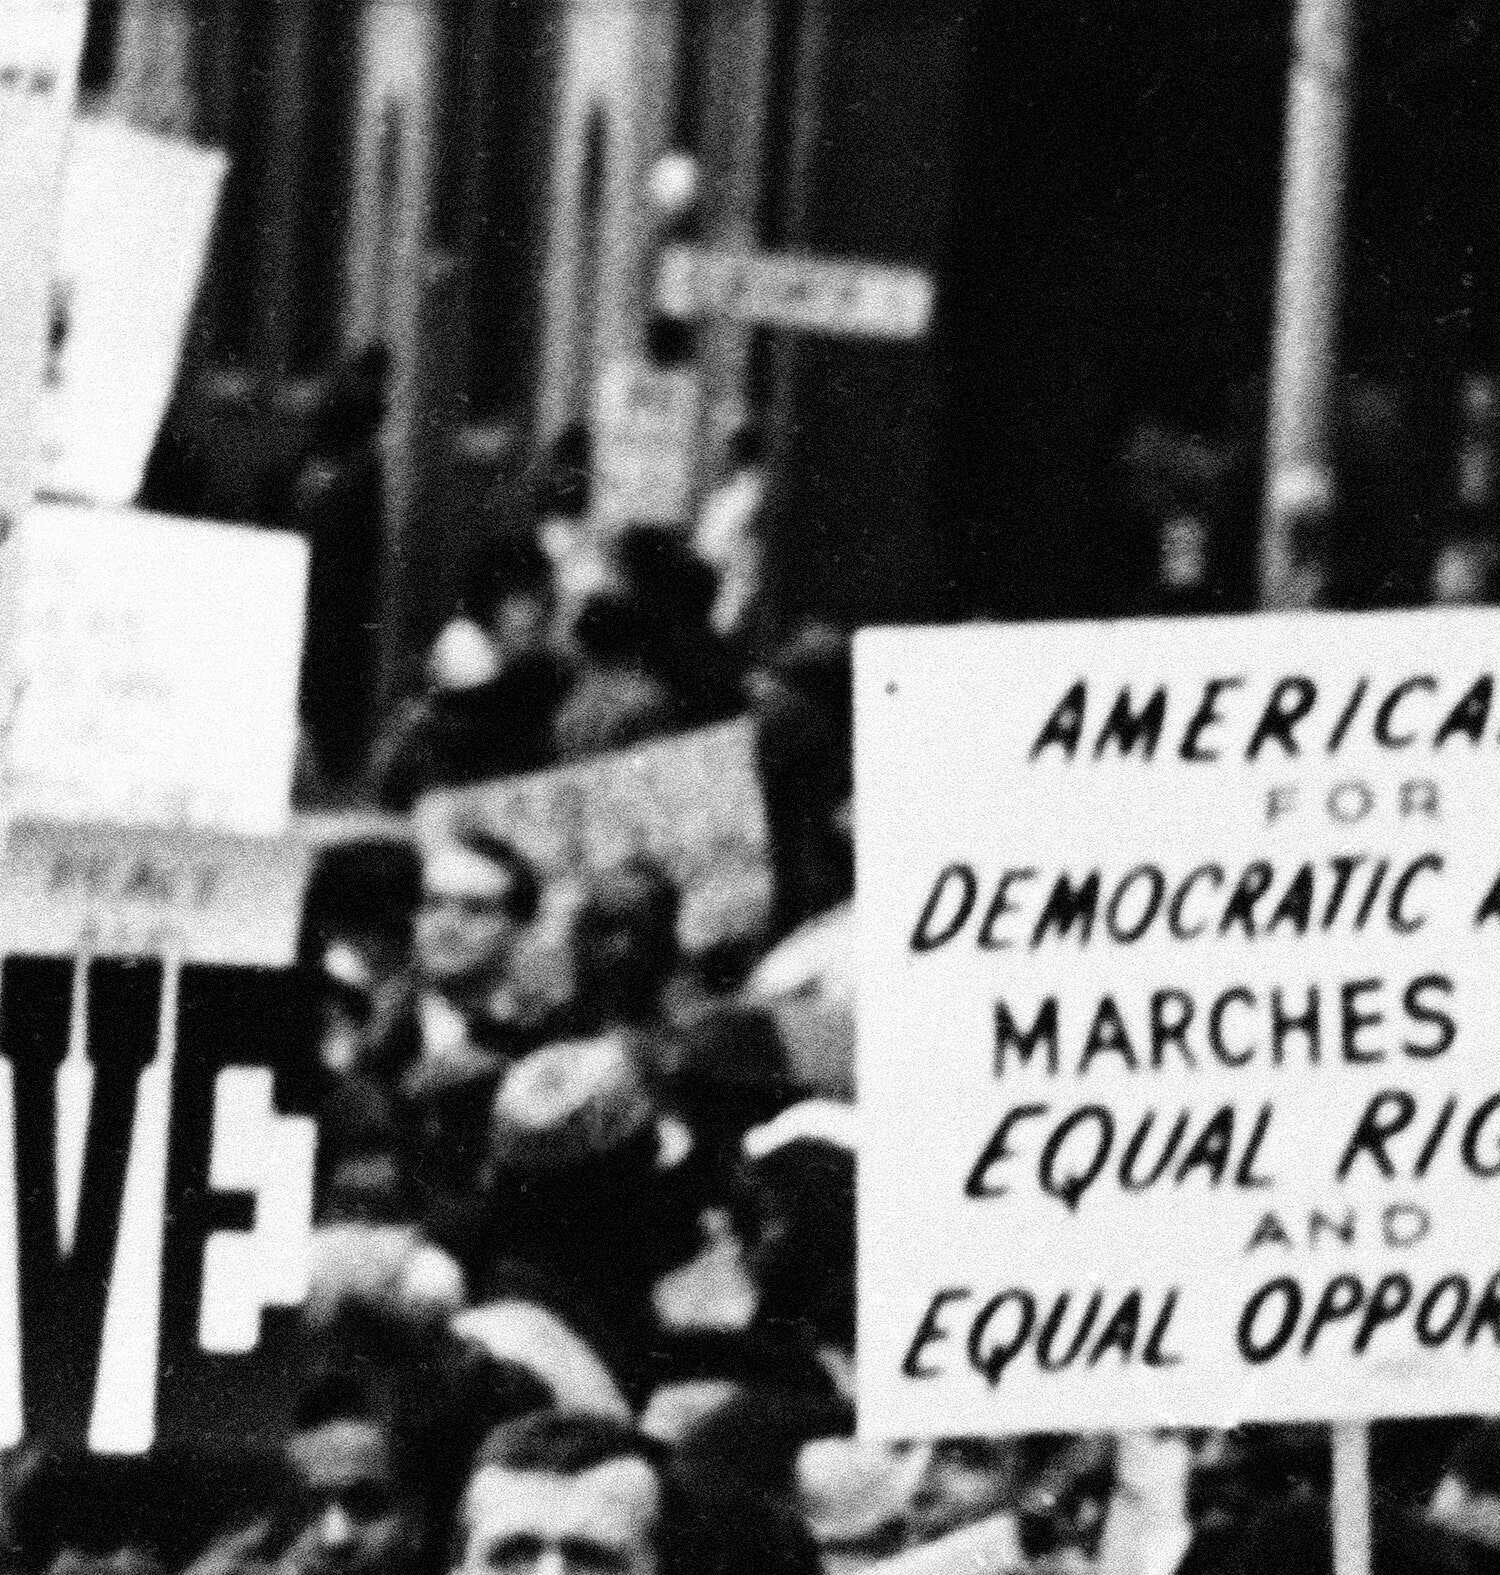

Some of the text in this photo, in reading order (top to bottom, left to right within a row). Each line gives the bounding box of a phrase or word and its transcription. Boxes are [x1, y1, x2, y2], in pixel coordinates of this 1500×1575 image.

[1264, 778, 1443, 825] FOR
[910, 851, 1443, 954] DEMOCRATIC
[993, 974, 1460, 1076] MARCHES
[963, 1100, 1274, 1211] EQUAL
[1245, 1201, 1431, 1254] AND
[901, 1285, 1181, 1388] EQUAL
